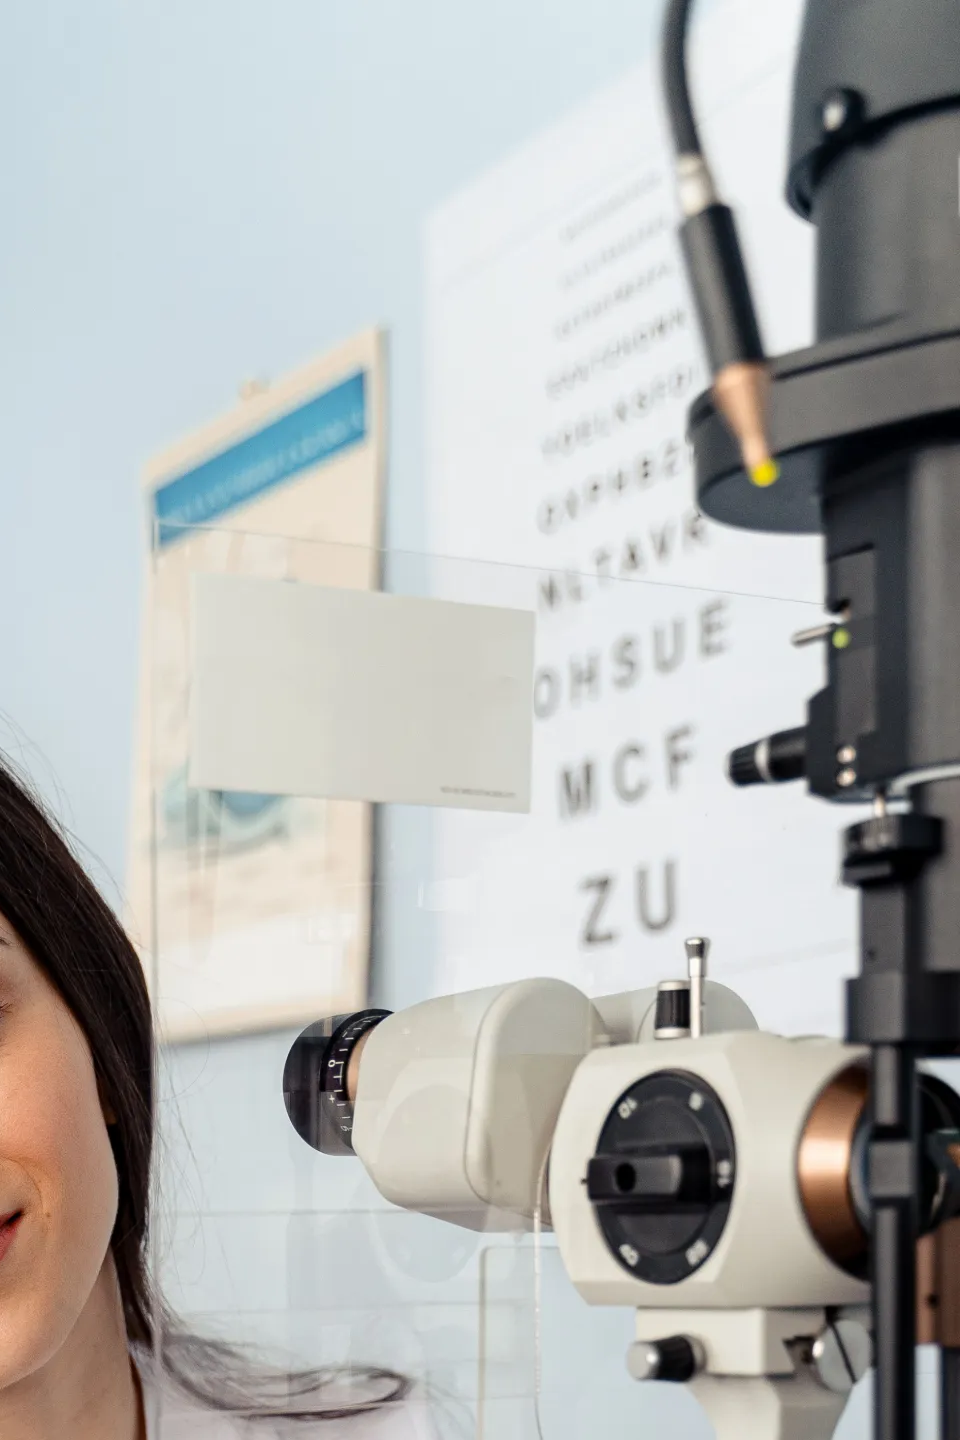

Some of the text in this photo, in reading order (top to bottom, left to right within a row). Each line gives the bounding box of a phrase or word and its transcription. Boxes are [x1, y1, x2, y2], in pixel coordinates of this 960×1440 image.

[534, 598, 728, 720] OHSUE
[559, 724, 694, 822] MCF
[581, 857, 675, 946] ZU
